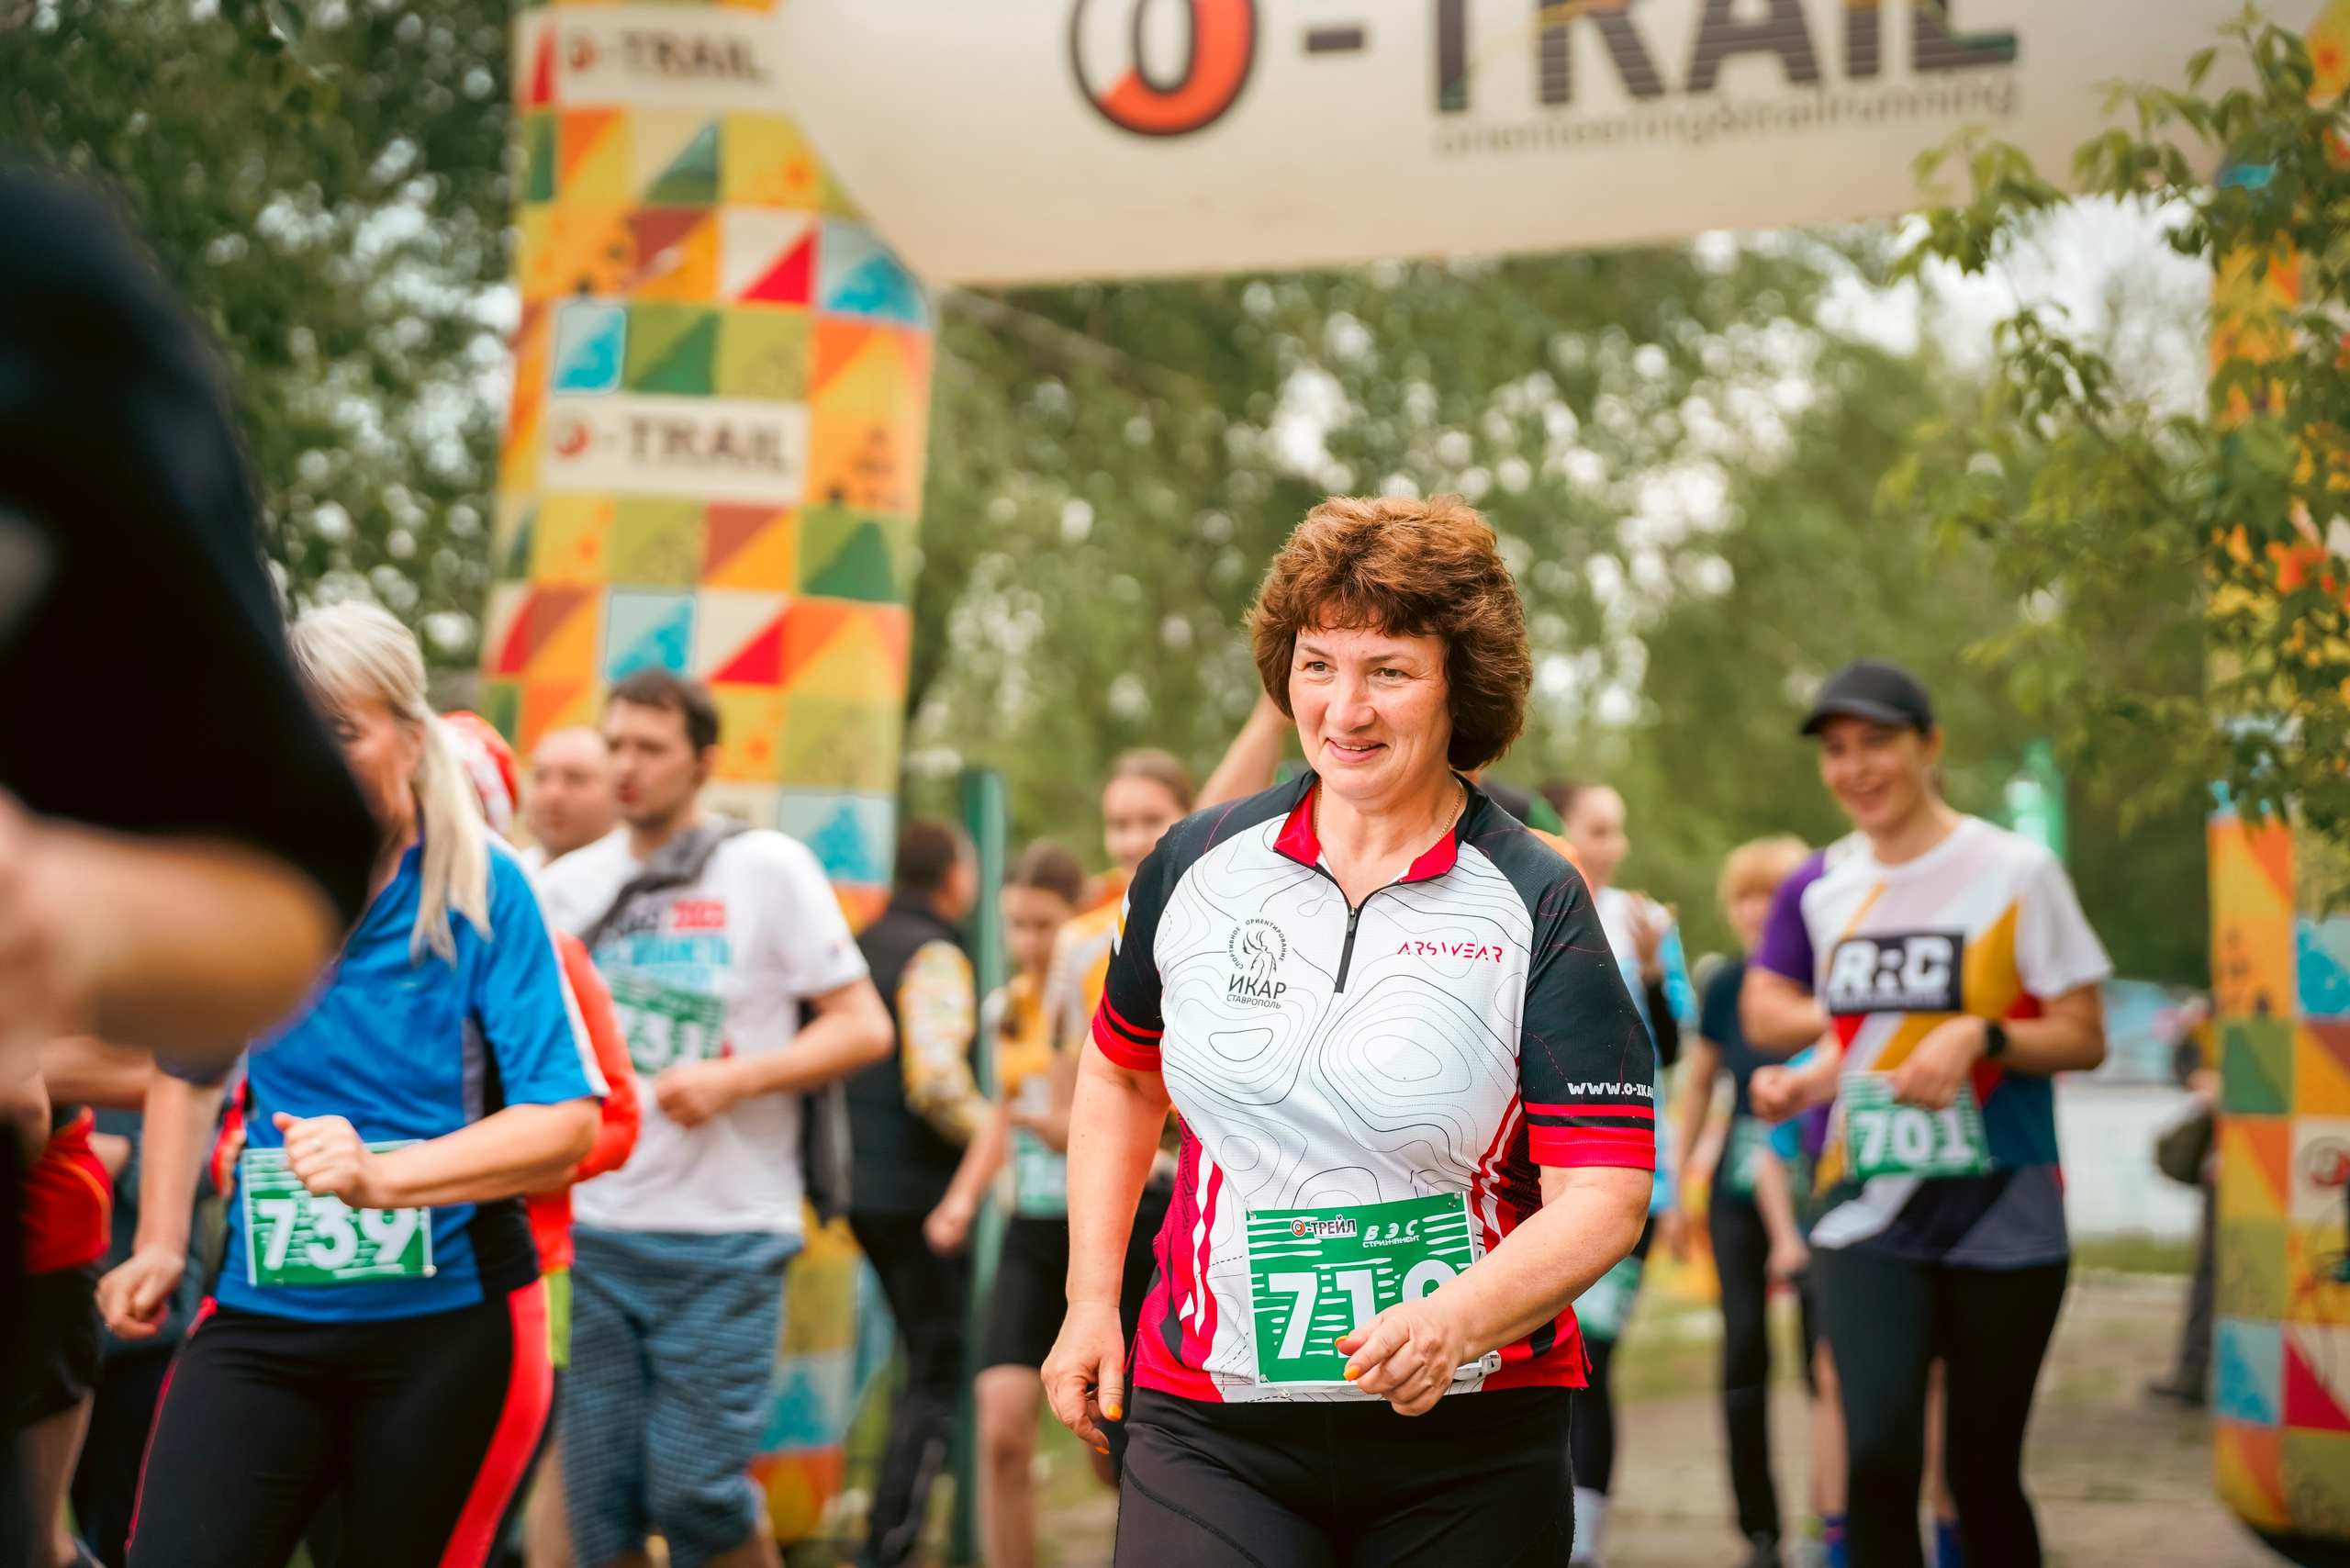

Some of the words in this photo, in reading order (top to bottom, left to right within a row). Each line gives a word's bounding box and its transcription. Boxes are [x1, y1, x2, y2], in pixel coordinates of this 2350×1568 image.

[1245, 918, 1287, 962] ОРИЕНТИРОВАНИЕ
[1397, 941, 1504, 963] ARSWEAR
[1226, 993, 1281, 1009] СТАВРОПОЛЬ
[1228, 973, 1287, 999] ИКАР
[1854, 1106, 1973, 1168] 701
[257, 1196, 420, 1271] 739
